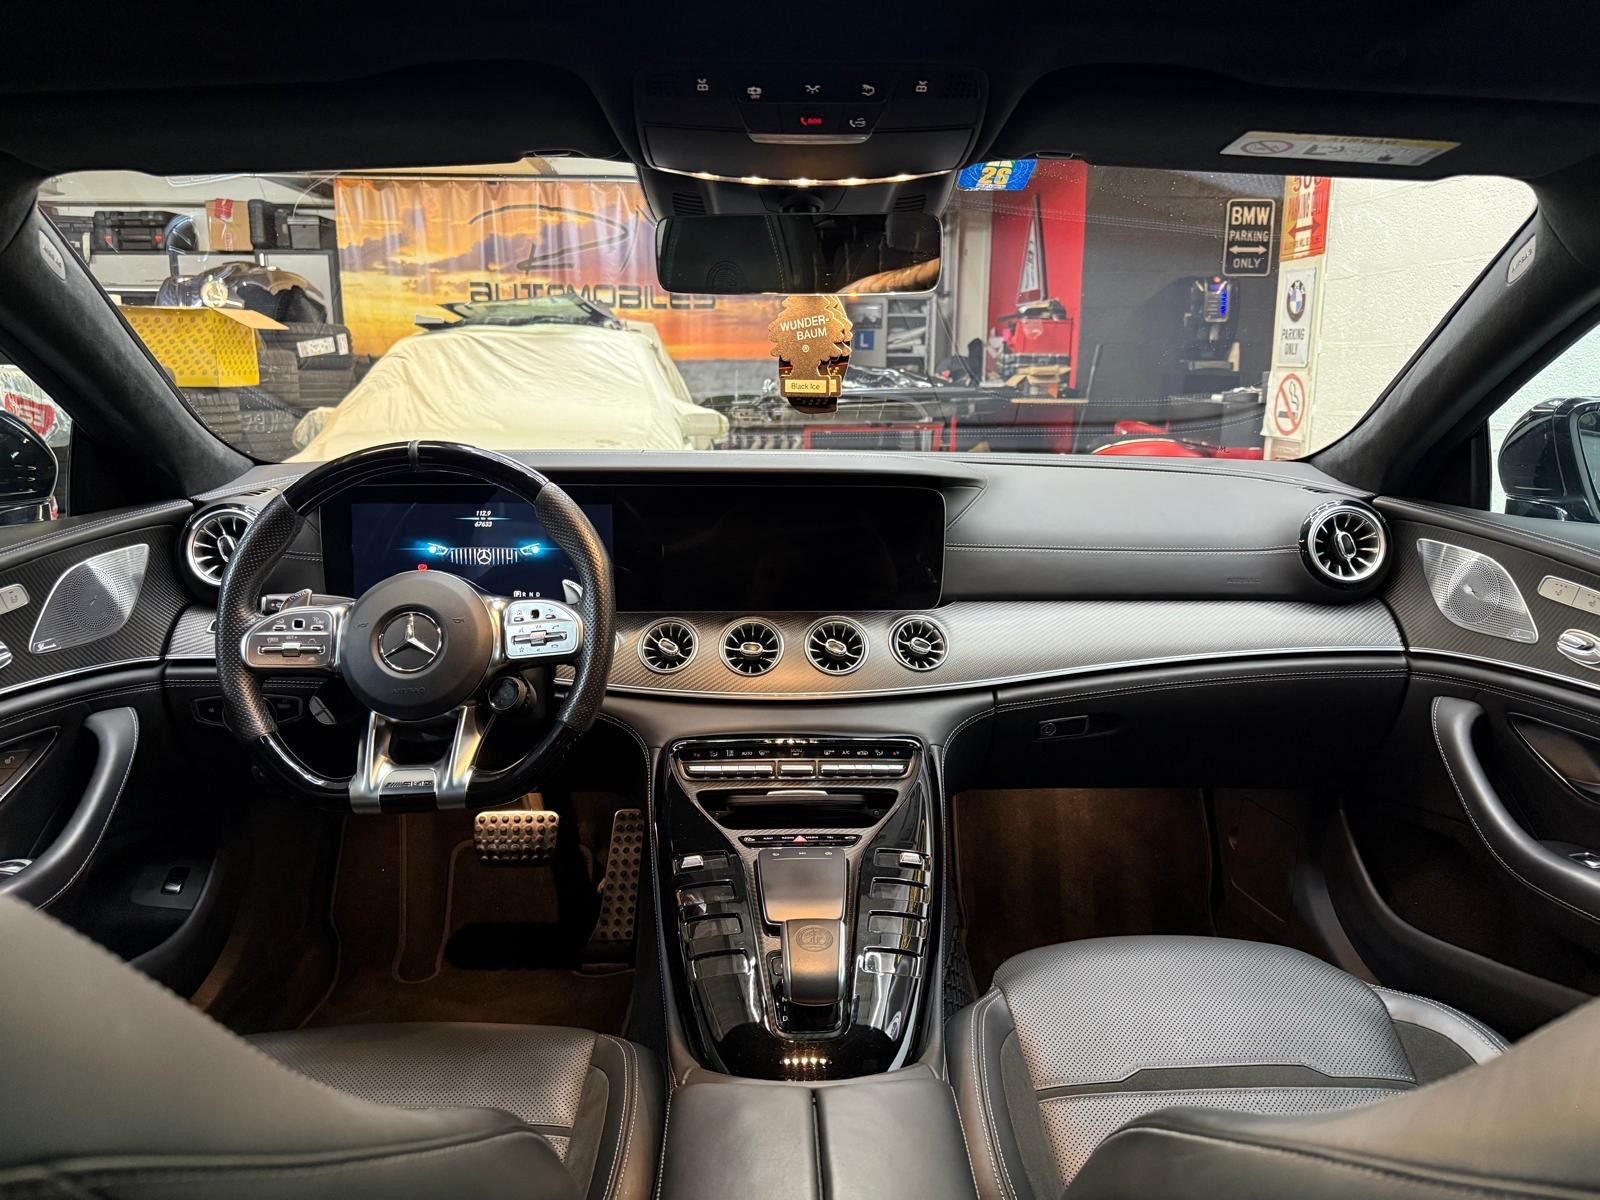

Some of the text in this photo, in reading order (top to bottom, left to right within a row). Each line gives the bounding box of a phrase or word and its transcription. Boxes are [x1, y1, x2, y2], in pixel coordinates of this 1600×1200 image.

[1231, 206, 1270, 226] BMW
[1229, 230, 1269, 242] PARKING
[1233, 258, 1261, 268] ONLY
[780, 314, 829, 332] WUNDER-
[796, 327, 828, 341] BAUM
[1281, 328, 1305, 340] PARKING
[861, 334, 869, 348] L
[1284, 343, 1299, 355] ONLY
